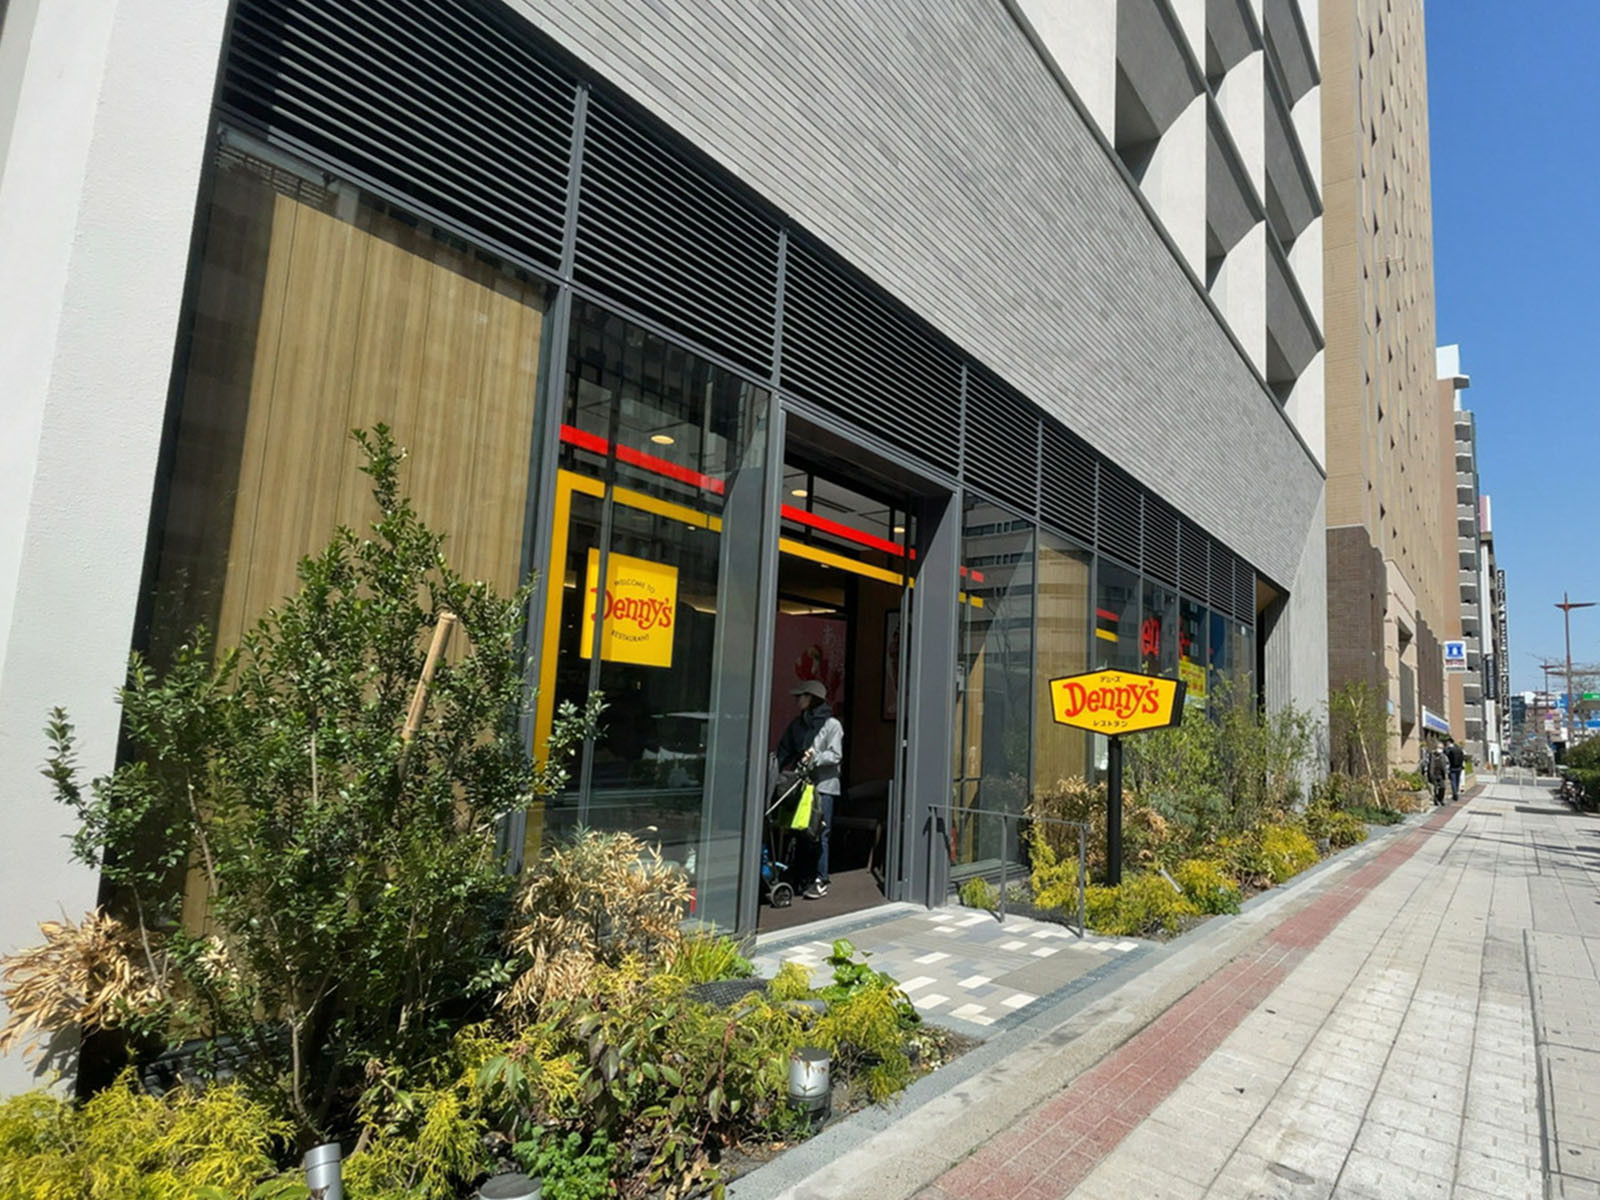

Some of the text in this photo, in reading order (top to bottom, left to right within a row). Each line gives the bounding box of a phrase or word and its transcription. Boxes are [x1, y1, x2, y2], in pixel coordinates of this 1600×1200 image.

[590, 588, 672, 630] Denny's
[611, 630, 649, 641] RESTAURANT
[1062, 680, 1159, 719] Denny's
[1093, 720, 1128, 728] レストラン
